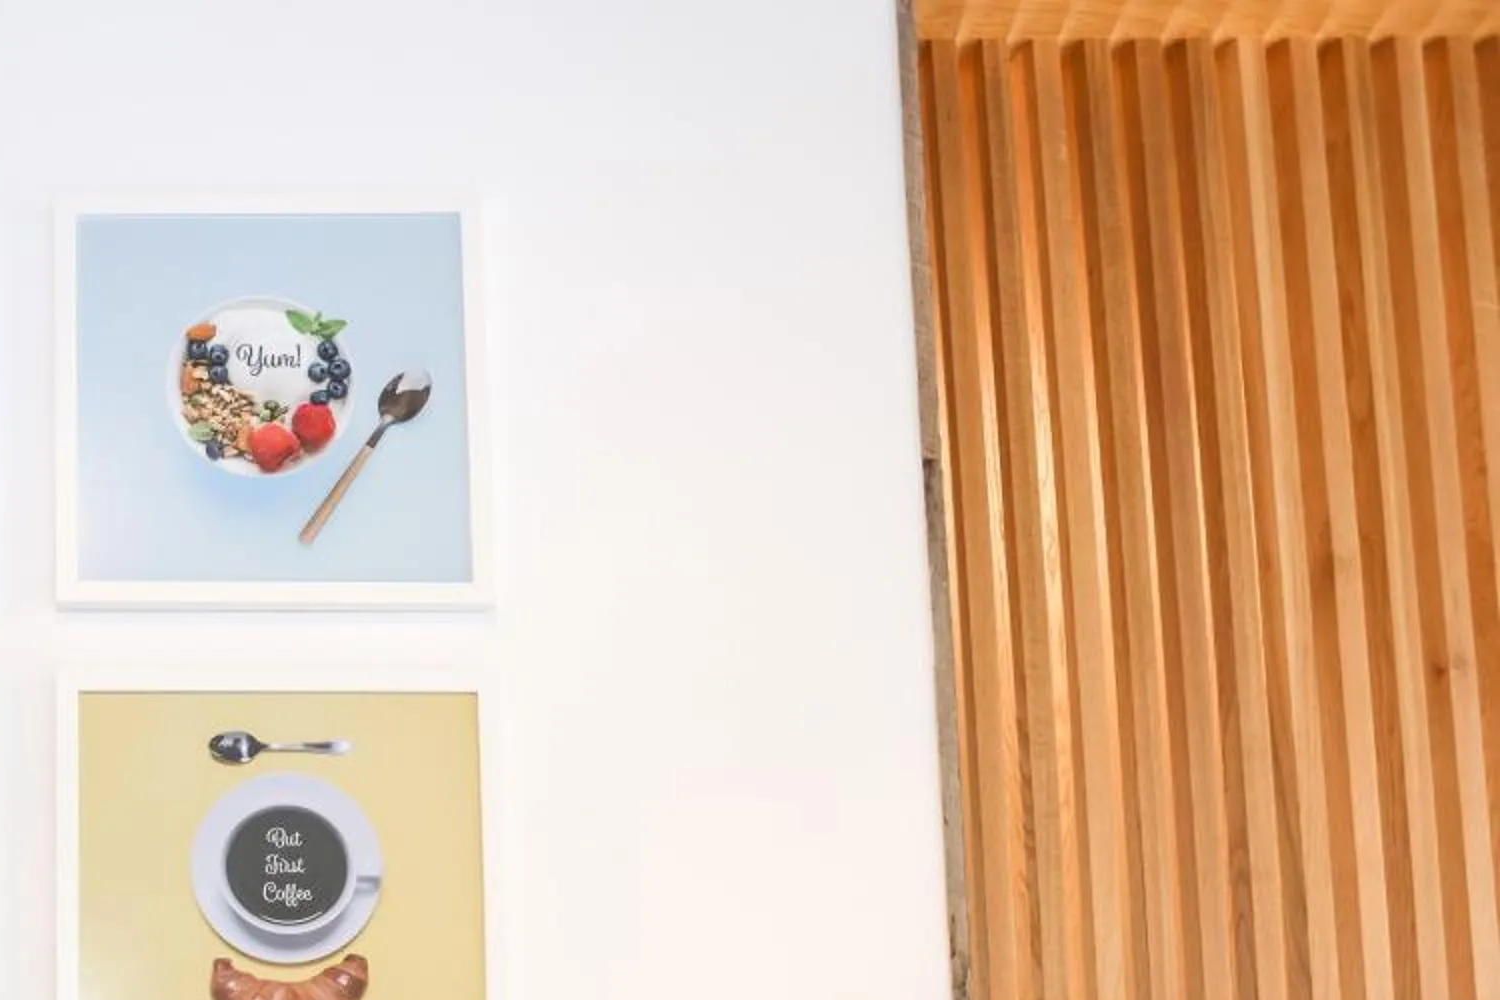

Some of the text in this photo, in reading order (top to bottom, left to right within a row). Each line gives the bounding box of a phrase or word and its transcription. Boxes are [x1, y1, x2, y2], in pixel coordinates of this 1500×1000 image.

[236, 343, 301, 376] Yum!
[265, 827, 303, 848] But
[265, 853, 306, 874] First
[263, 881, 313, 907] Coffee
